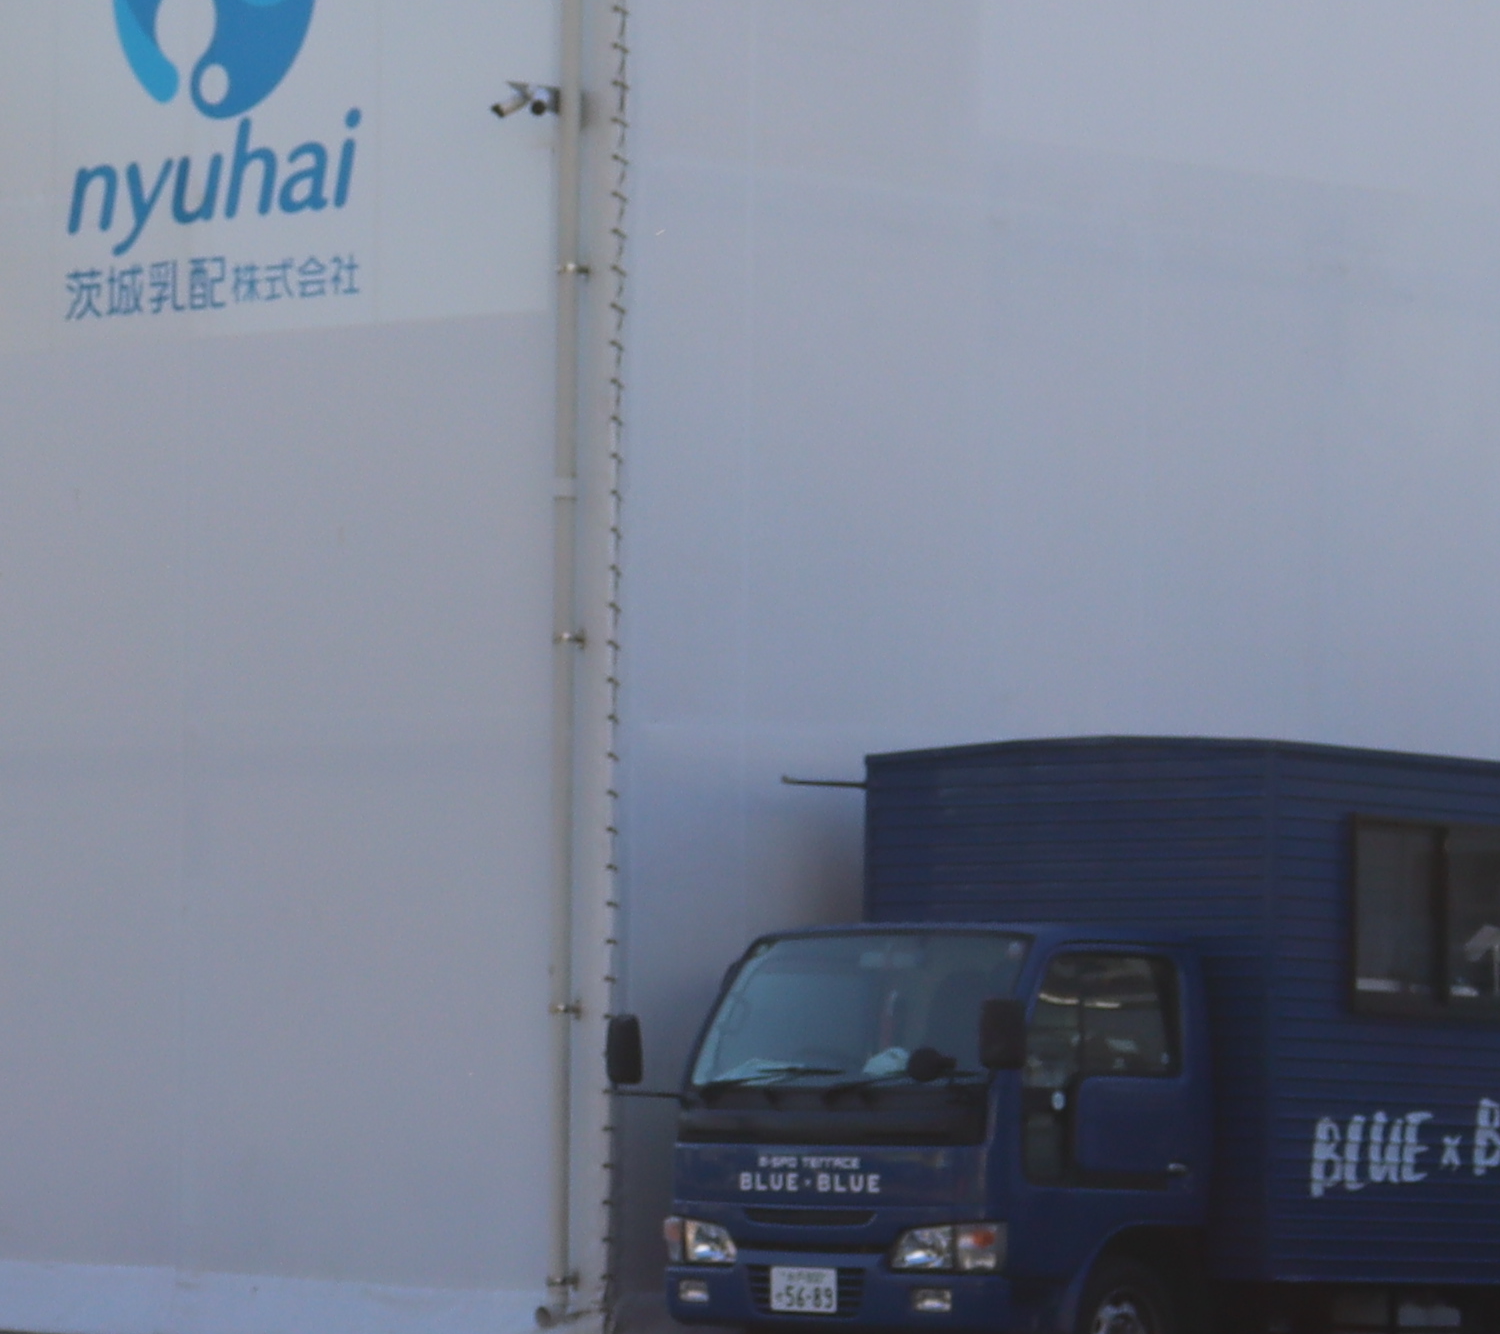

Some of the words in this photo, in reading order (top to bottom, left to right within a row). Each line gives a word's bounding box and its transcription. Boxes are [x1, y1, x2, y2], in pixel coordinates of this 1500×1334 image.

[66, 107, 362, 256] nyuhai
[739, 1171, 799, 1192] BLUE
[816, 1172, 881, 1194] BLUE
[1309, 1110, 1434, 1198] BLUE
